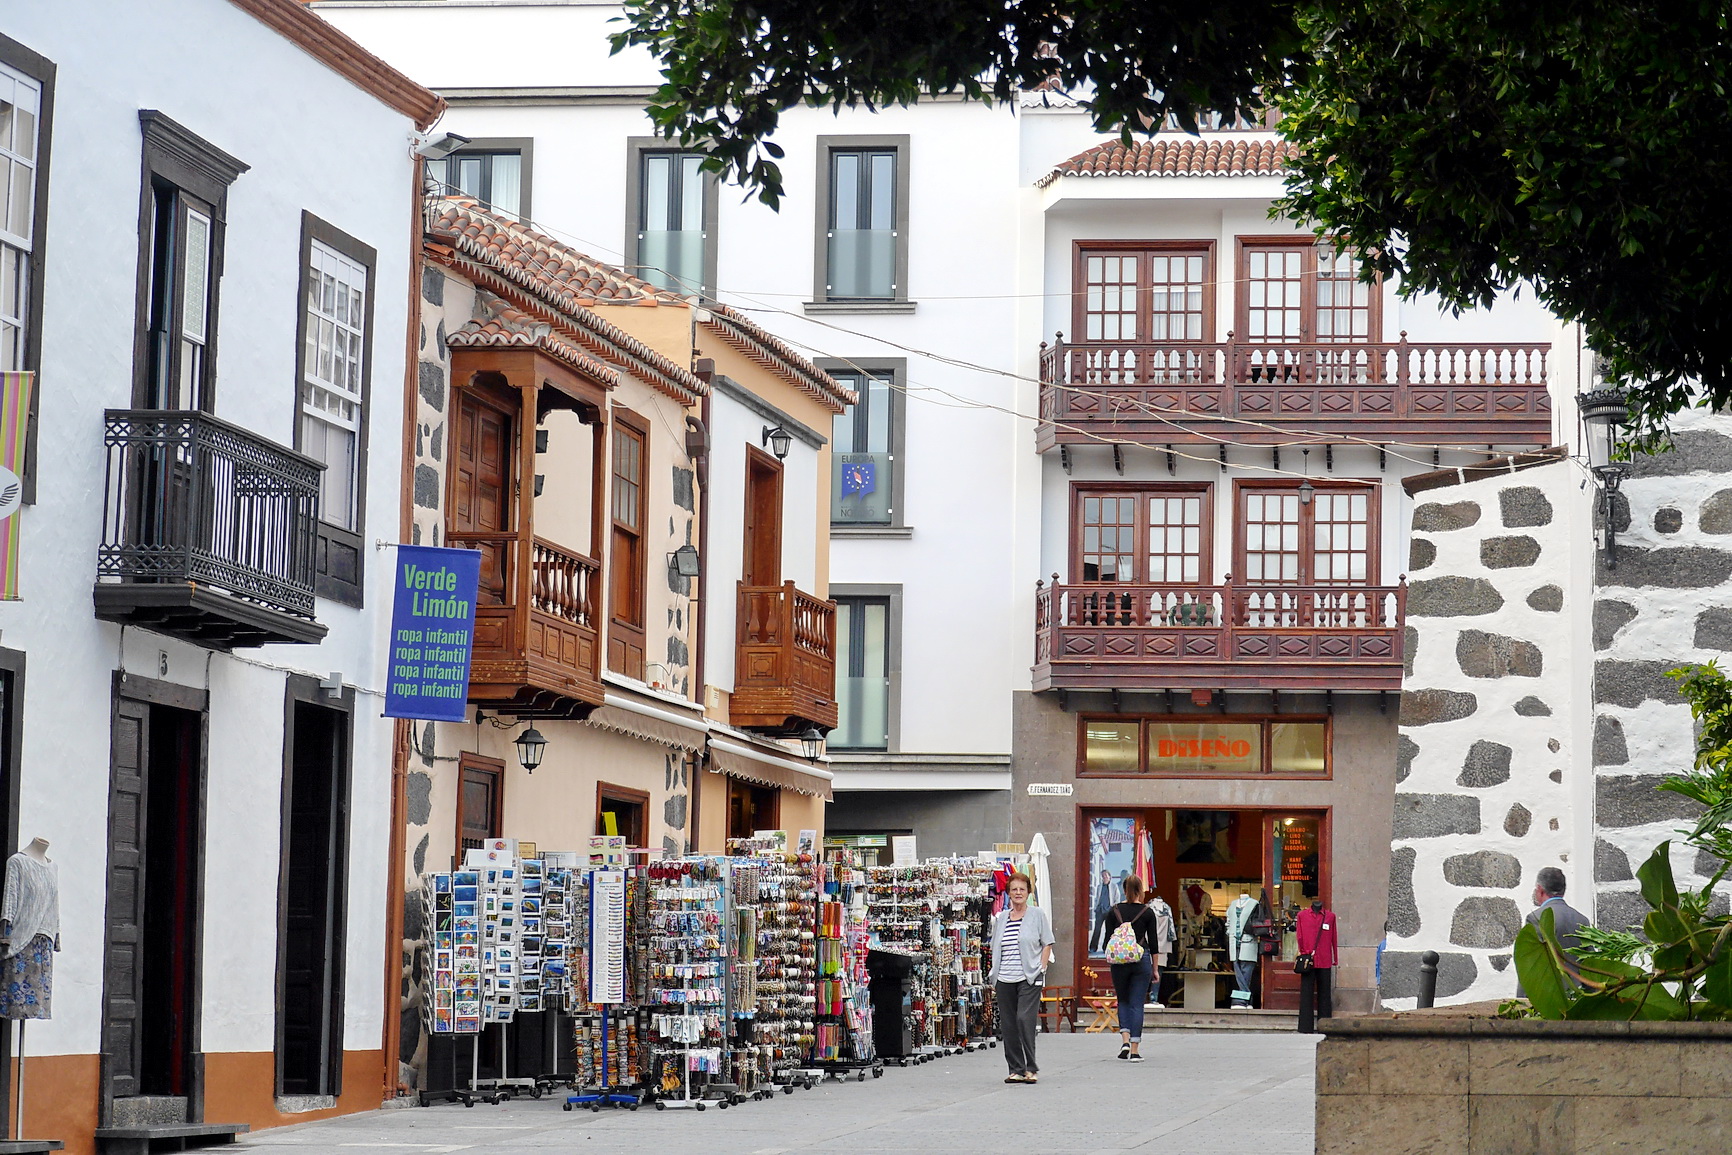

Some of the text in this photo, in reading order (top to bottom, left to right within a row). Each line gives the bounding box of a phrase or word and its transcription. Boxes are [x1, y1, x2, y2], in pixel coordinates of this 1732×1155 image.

[841, 455, 875, 464] EUROPA
[404, 563, 457, 592] Verde
[412, 591, 469, 620] Limón
[397, 627, 468, 646] ropa infantil
[395, 645, 466, 664] ropa infantil
[394, 663, 465, 681] ropa infantil
[393, 681, 463, 699] ropa infantil
